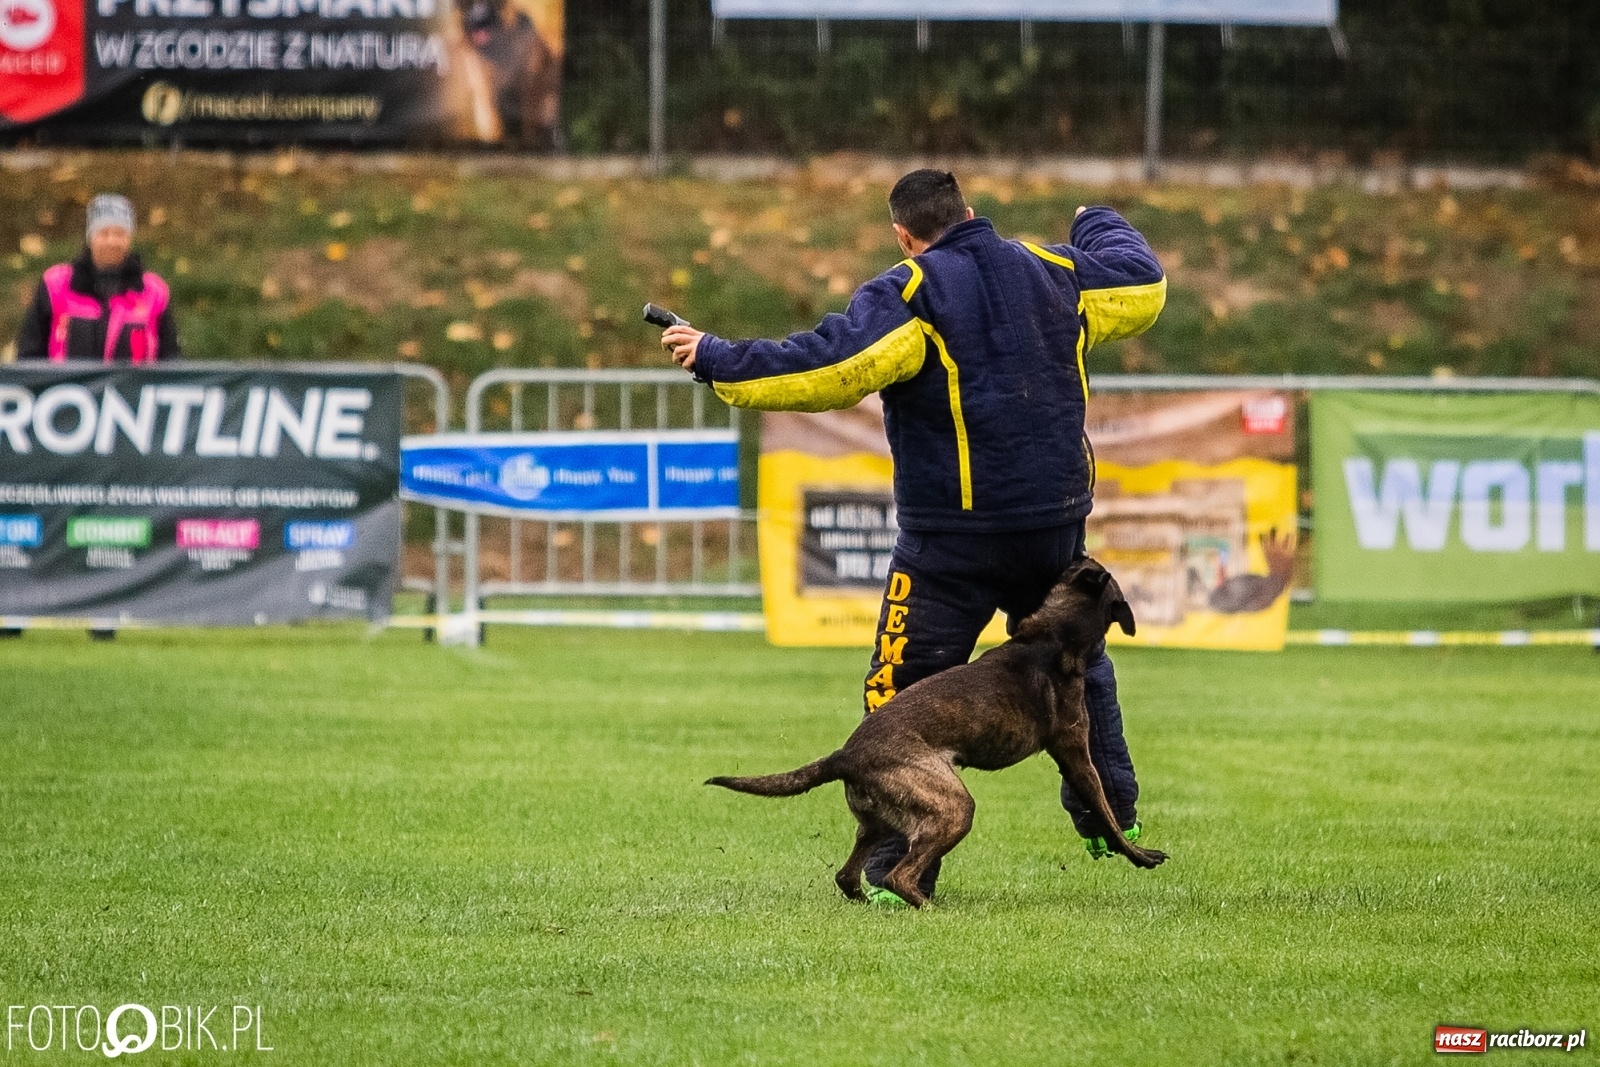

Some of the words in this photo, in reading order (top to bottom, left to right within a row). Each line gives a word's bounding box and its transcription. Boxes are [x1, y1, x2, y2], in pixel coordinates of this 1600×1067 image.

[95, 31, 133, 69] W
[135, 31, 280, 69] ZGODZIE
[1344, 431, 1600, 552] wor
